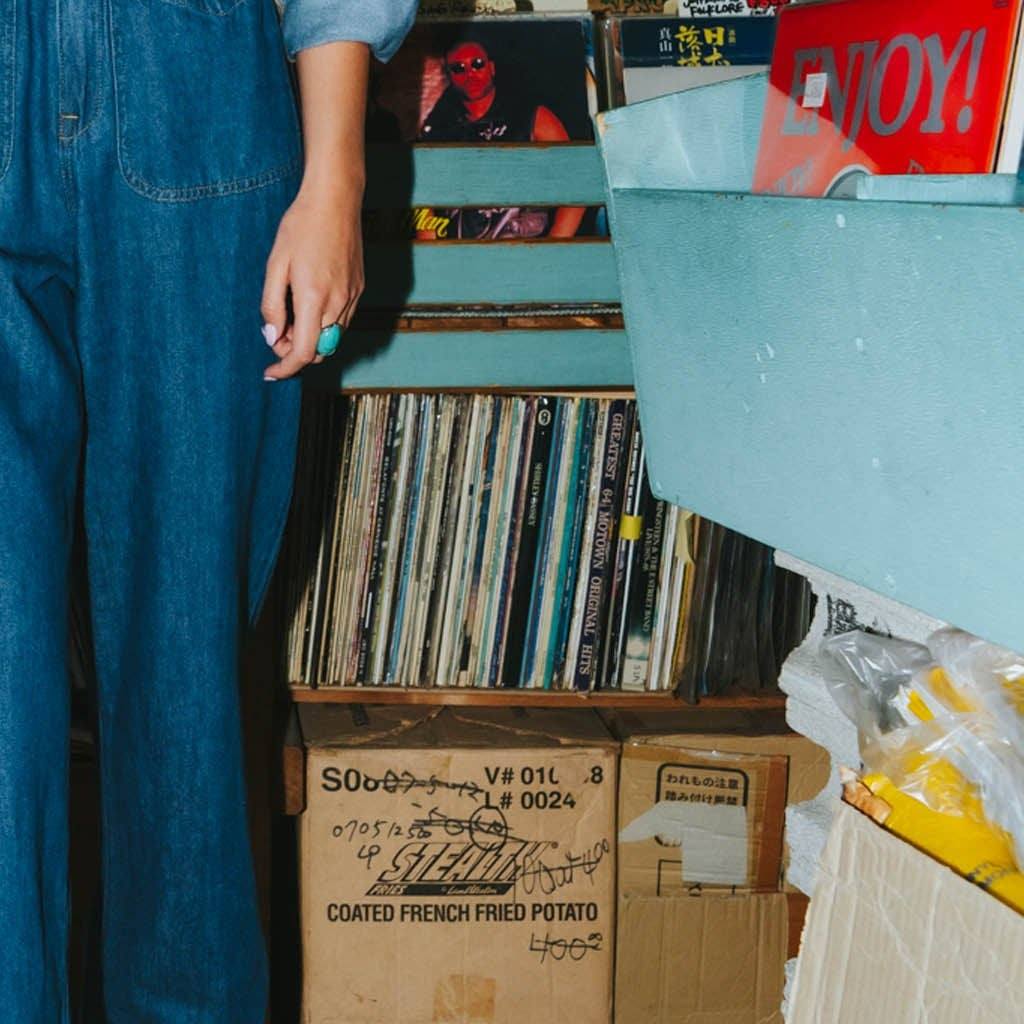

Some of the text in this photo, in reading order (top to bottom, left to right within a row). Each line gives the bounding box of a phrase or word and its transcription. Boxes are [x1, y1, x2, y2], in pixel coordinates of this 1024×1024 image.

[781, 27, 986, 152] ENJOY!
[605, 413, 624, 480] GREATEST
[592, 510, 611, 569] MOTOWN
[584, 576, 602, 636] ORIGINAL
[579, 644, 593, 675] HITS
[666, 774, 739, 790] われもの注意
[520, 791, 576, 810] 0024
[370, 885, 408, 895] FRIES
[327, 902, 598, 923] COATED FRENCH FRIED POTATO
